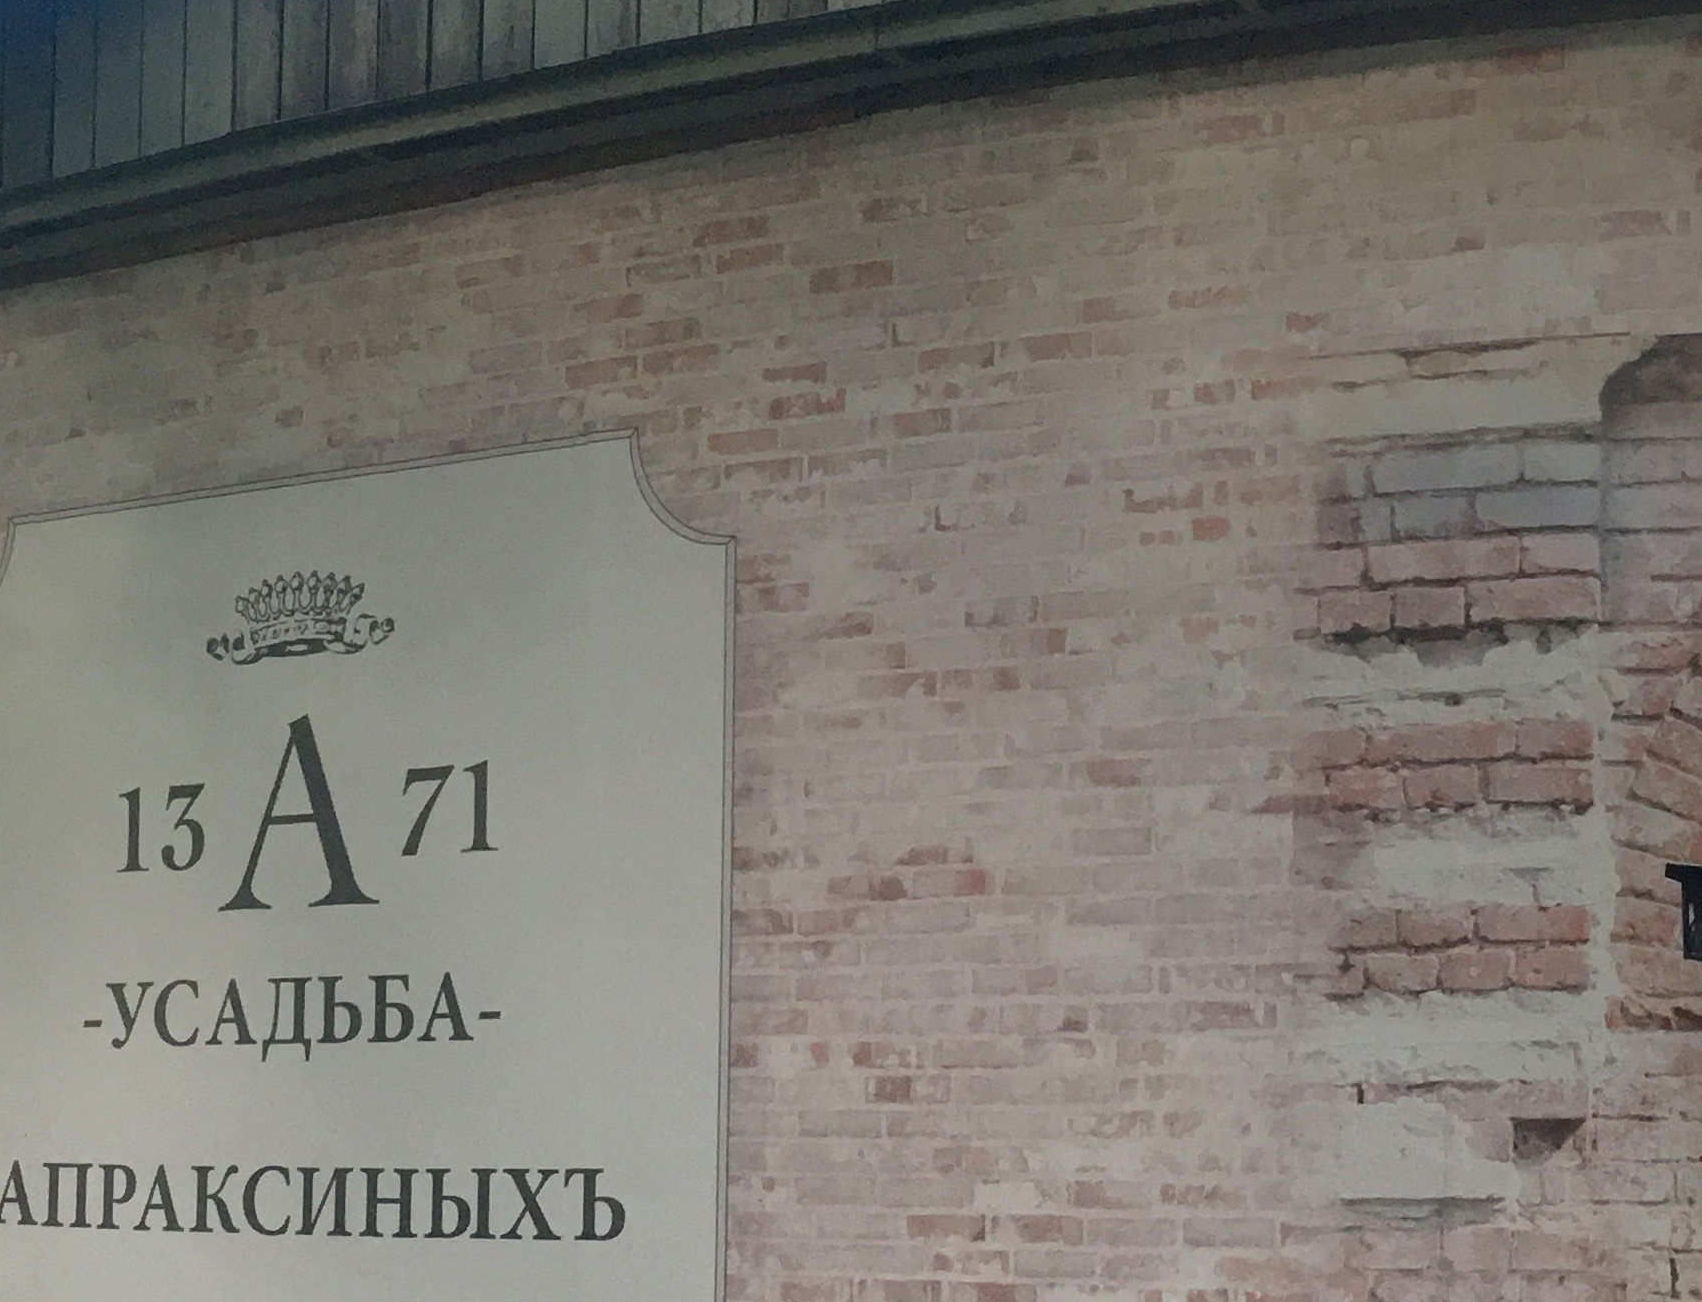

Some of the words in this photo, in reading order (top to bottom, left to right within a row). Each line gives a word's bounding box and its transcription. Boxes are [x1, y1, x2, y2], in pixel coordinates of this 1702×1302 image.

[116, 782, 206, 873] 13
[217, 713, 381, 912] А
[400, 759, 499, 857] 71
[83, 971, 502, 1063] -УСАДЬБА-
